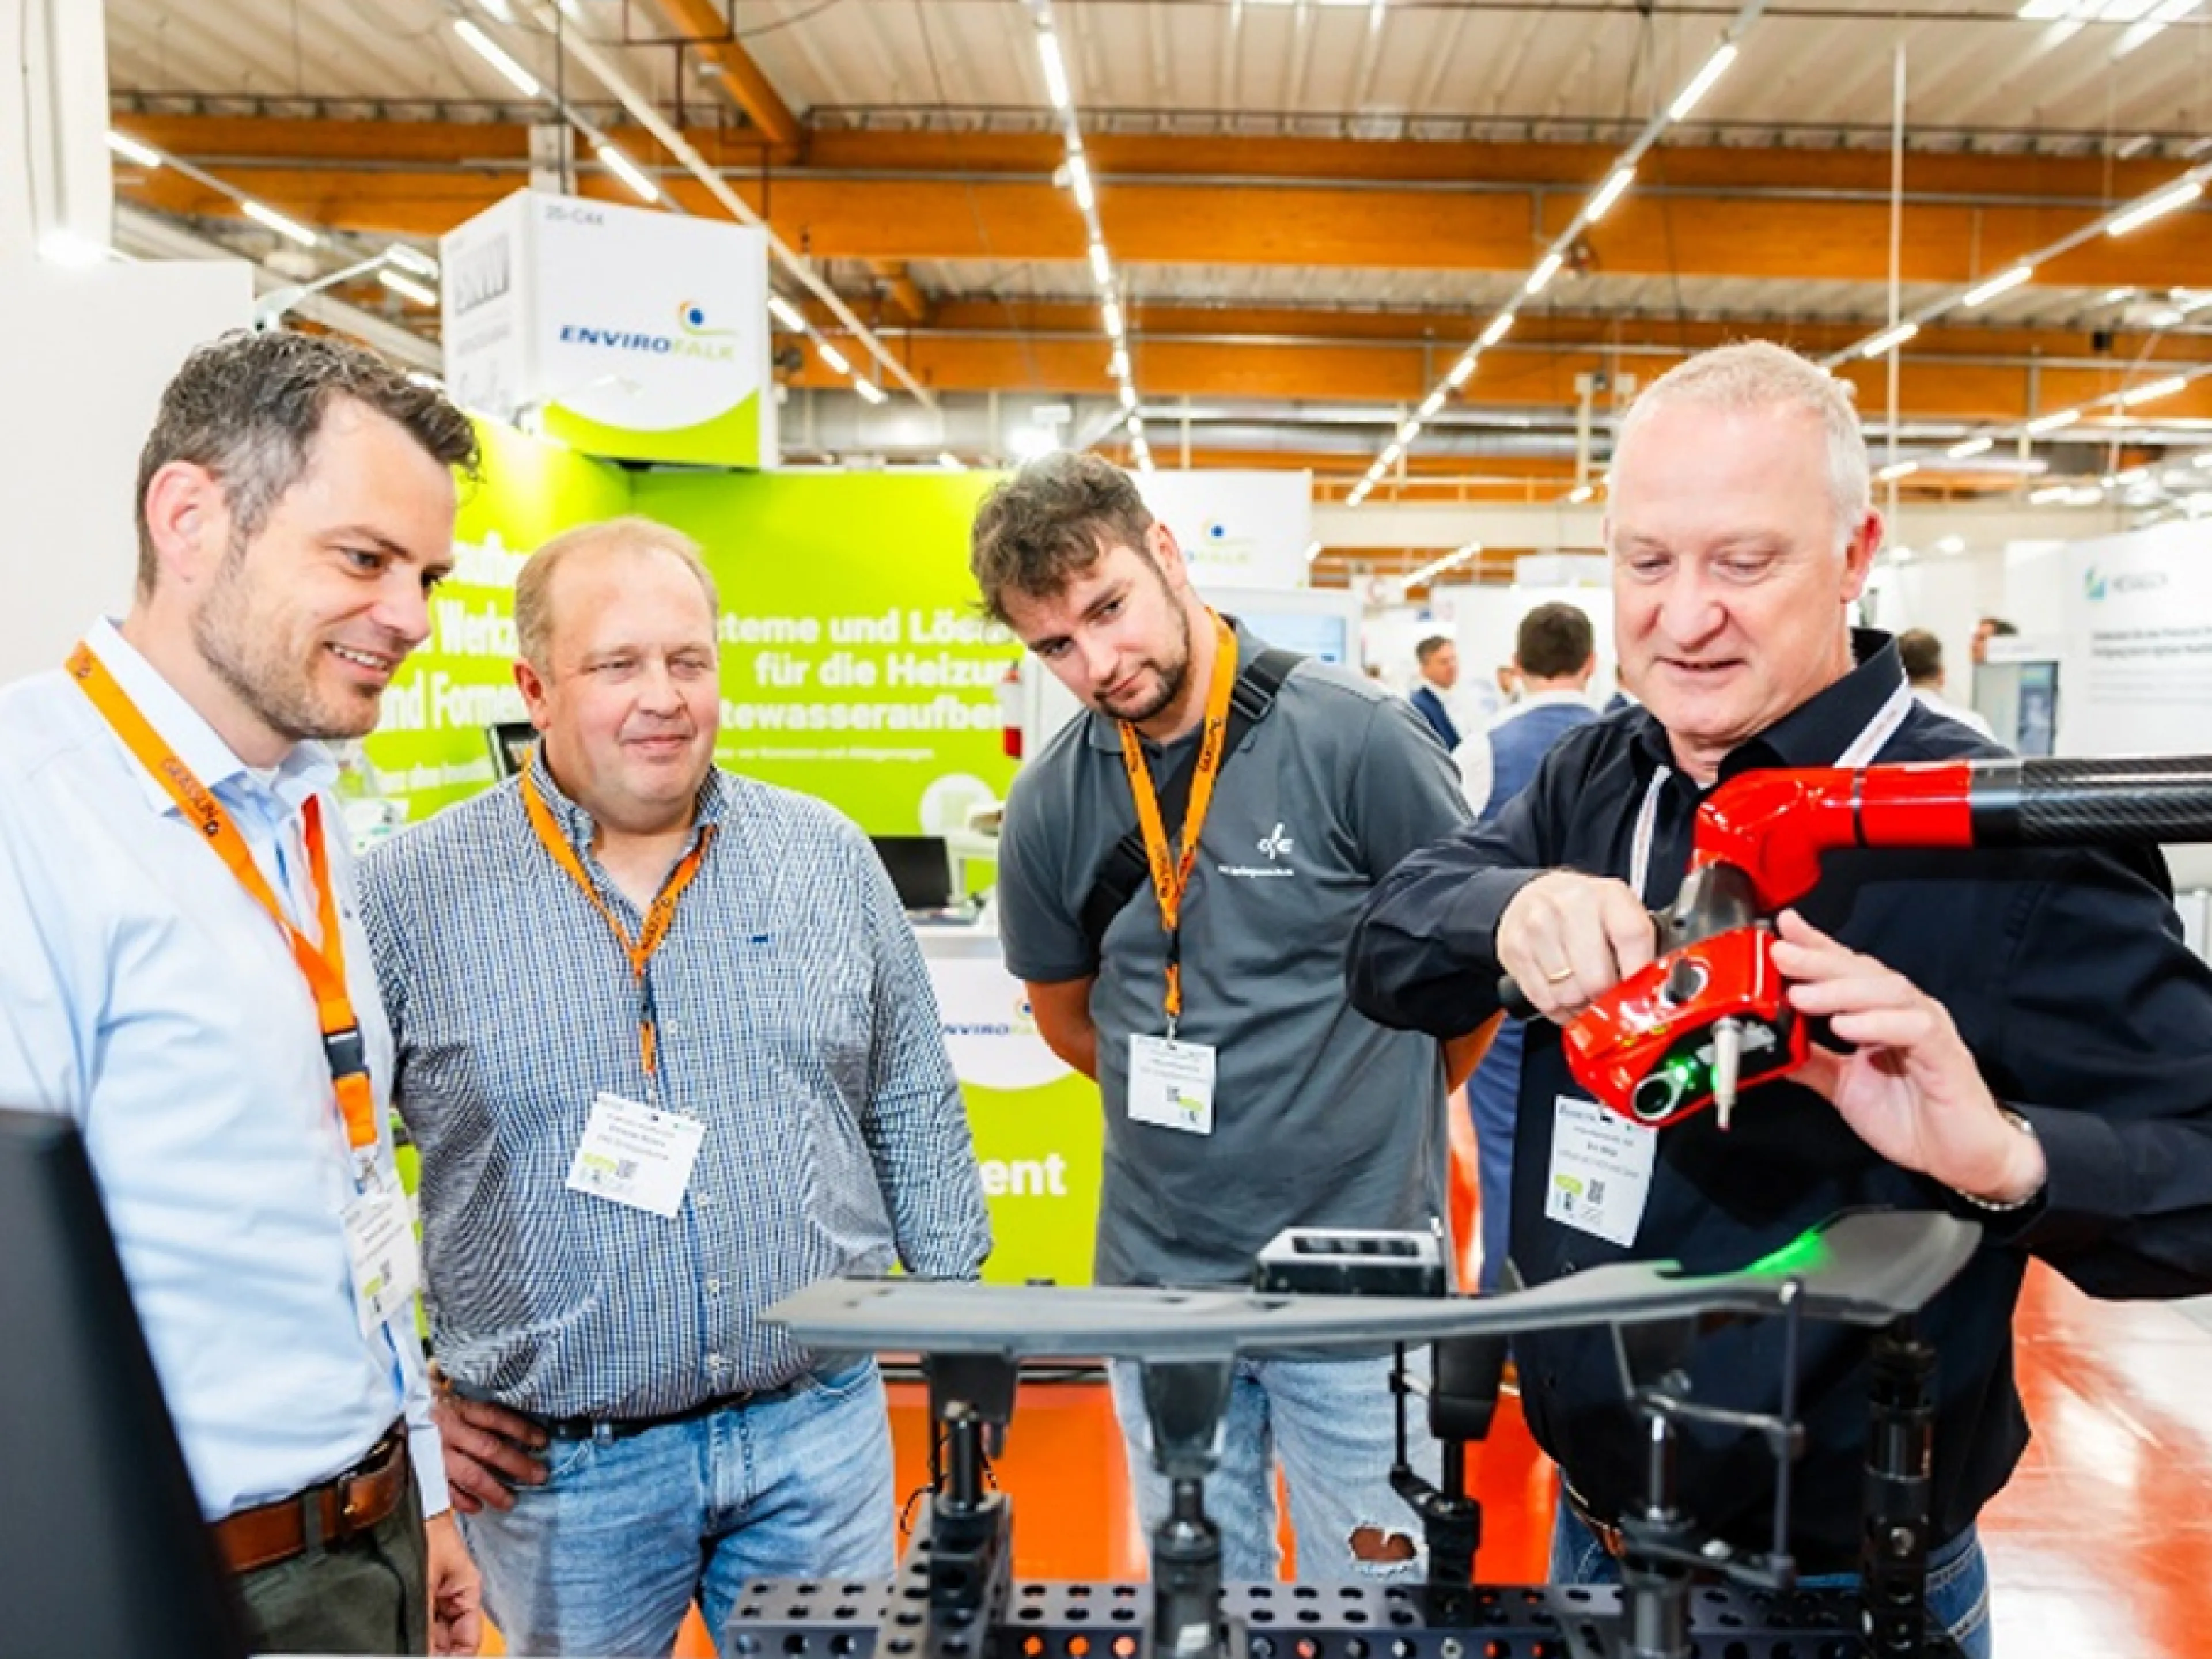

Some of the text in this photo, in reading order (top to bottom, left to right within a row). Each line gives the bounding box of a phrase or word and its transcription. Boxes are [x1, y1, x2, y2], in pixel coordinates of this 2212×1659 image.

[560, 324, 734, 360] ENVIROFALK
[830, 609, 900, 643] und
[755, 652, 809, 685] für
[819, 653, 876, 685] die
